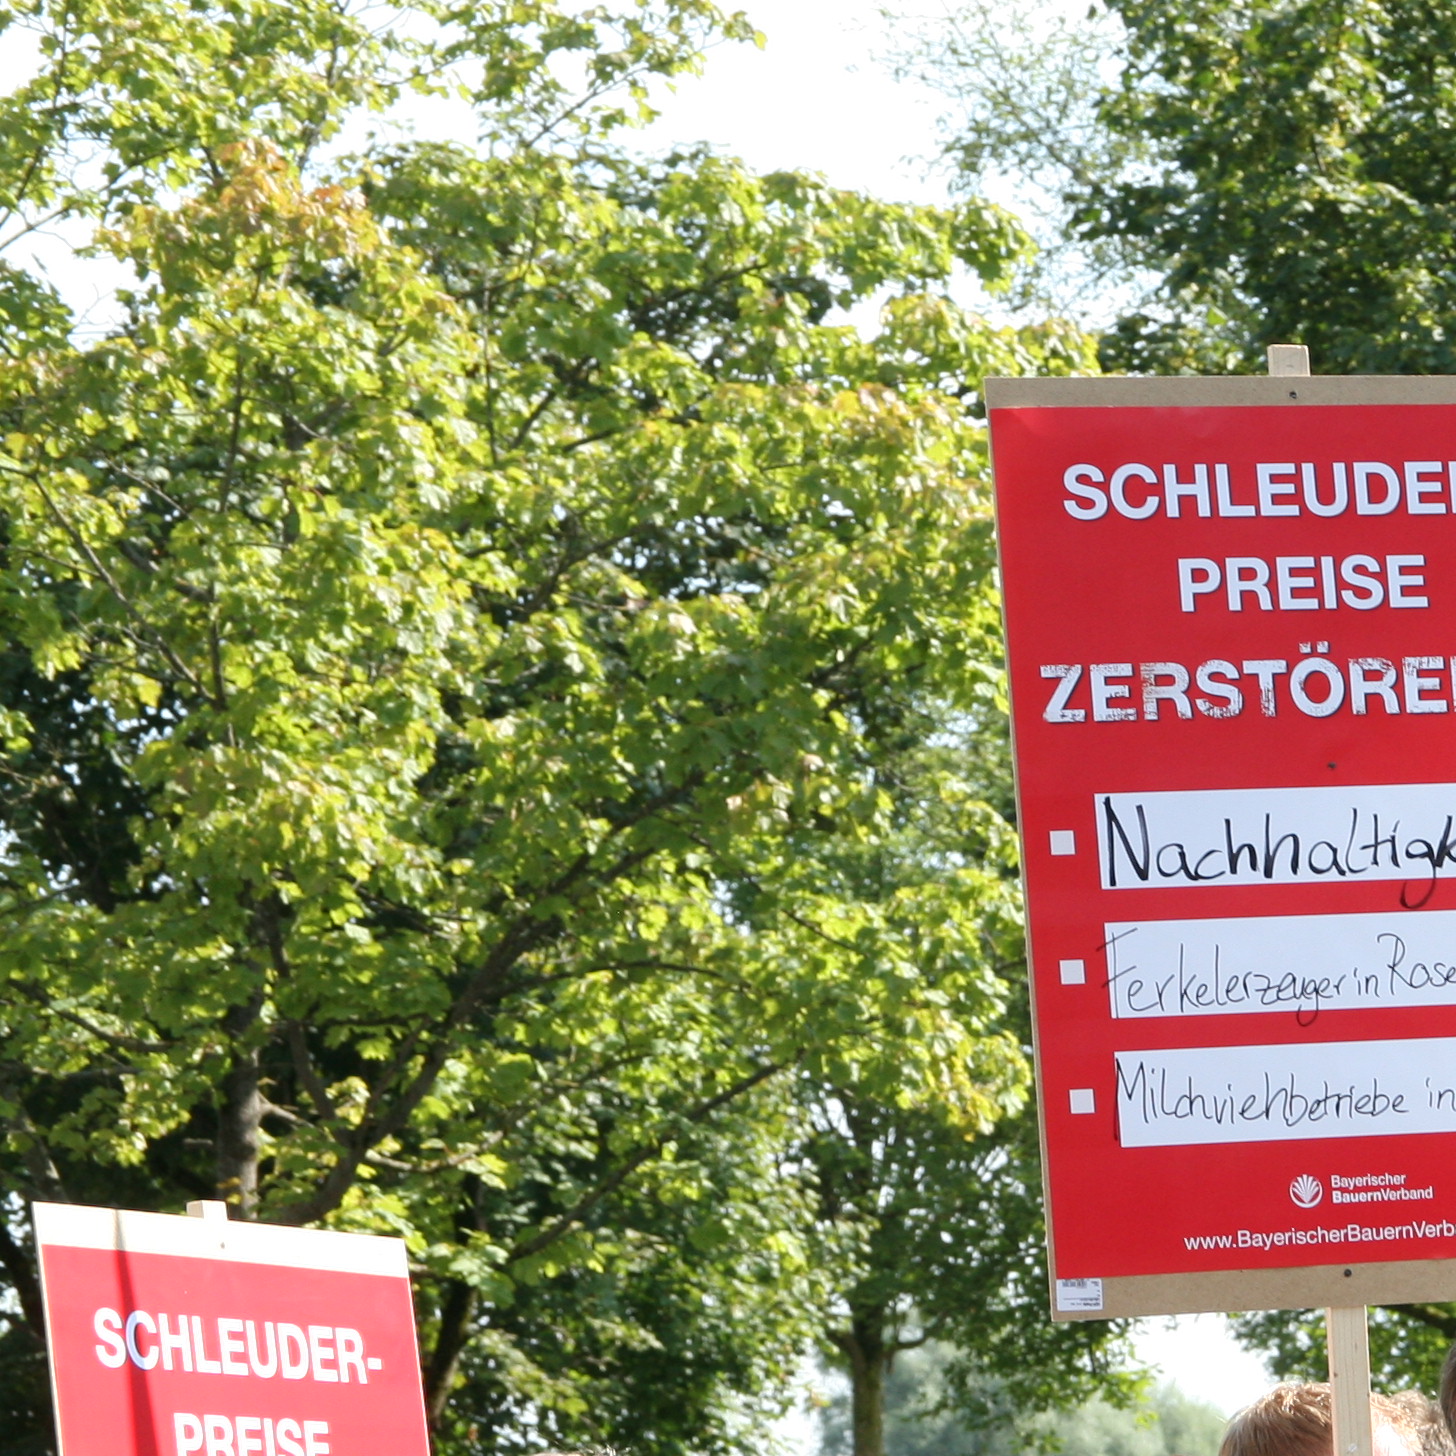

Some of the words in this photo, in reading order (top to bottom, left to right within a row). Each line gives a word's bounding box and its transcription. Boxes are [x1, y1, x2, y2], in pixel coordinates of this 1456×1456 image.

[1178, 554, 1429, 612] PREISE
[1097, 927, 1345, 1025] Ferkelerzeuger
[1355, 969, 1380, 999] in
[1113, 1057, 1409, 1142] Milchviehbetriebe
[1427, 1078, 1456, 1111] in
[1330, 1172, 1407, 1189] Bayerischer
[1332, 1185, 1434, 1203] BauernVerband
[93, 1306, 383, 1385] SCHLEUDER-
